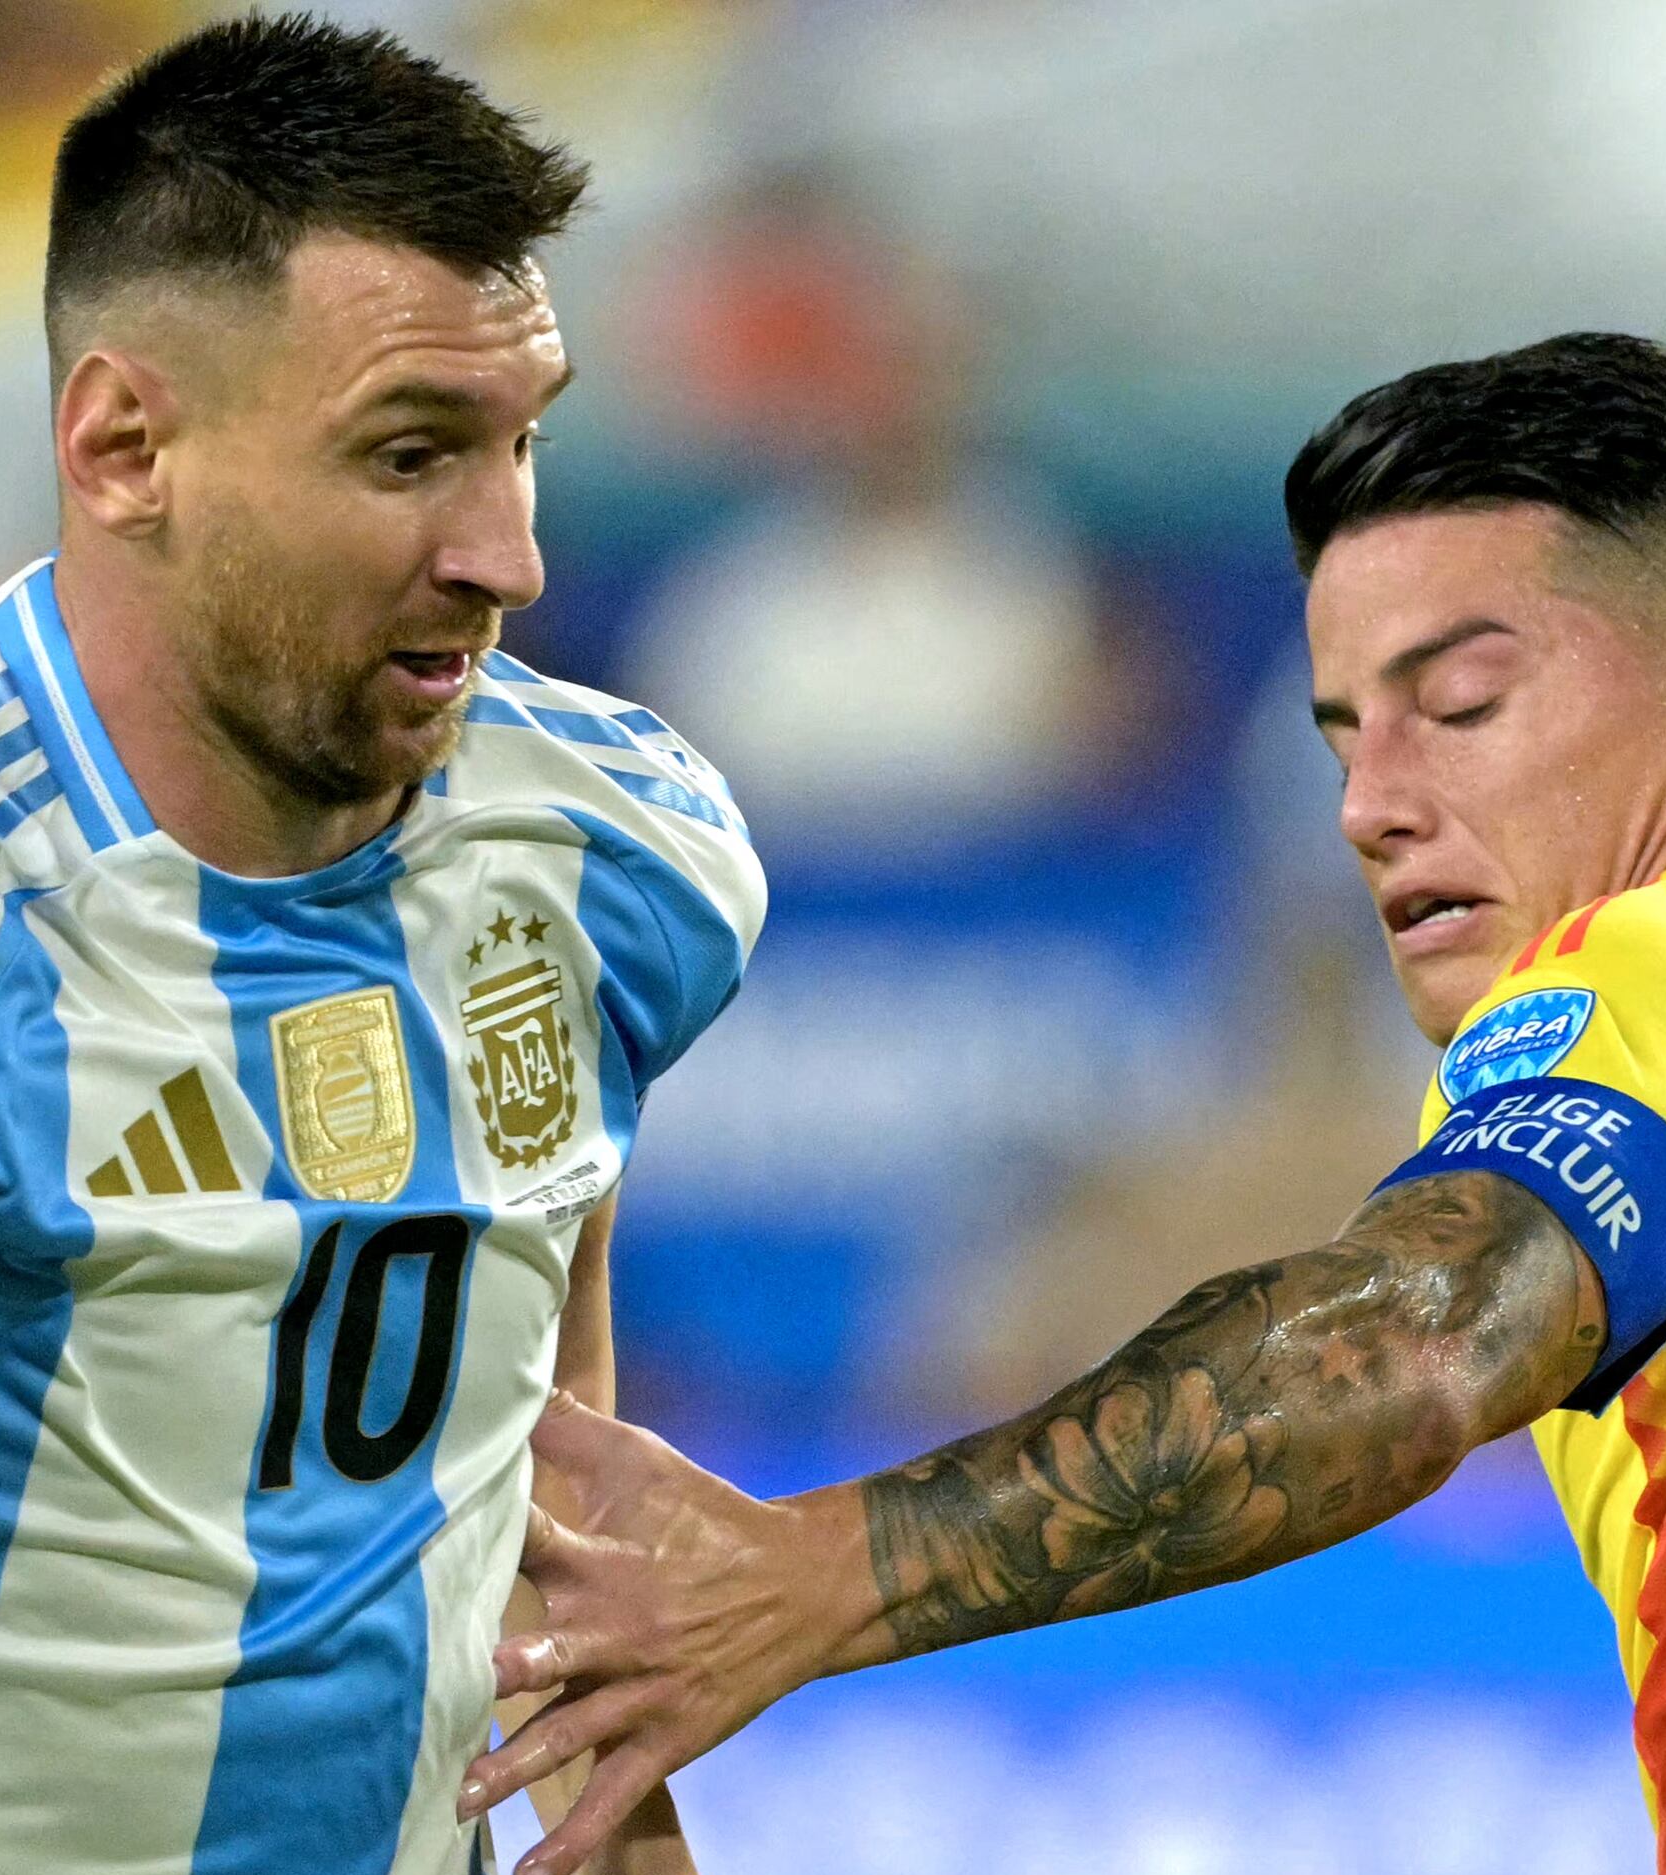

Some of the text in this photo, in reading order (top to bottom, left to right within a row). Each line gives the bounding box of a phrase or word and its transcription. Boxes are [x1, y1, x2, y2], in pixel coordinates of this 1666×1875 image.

[498, 1018, 559, 1108] AFA
[1455, 1014, 1571, 1065] VIBRA
[1478, 1092, 1632, 1149] ELIGE
[1440, 1120, 1643, 1252] INCLUIR
[257, 1212, 470, 1492] 10
